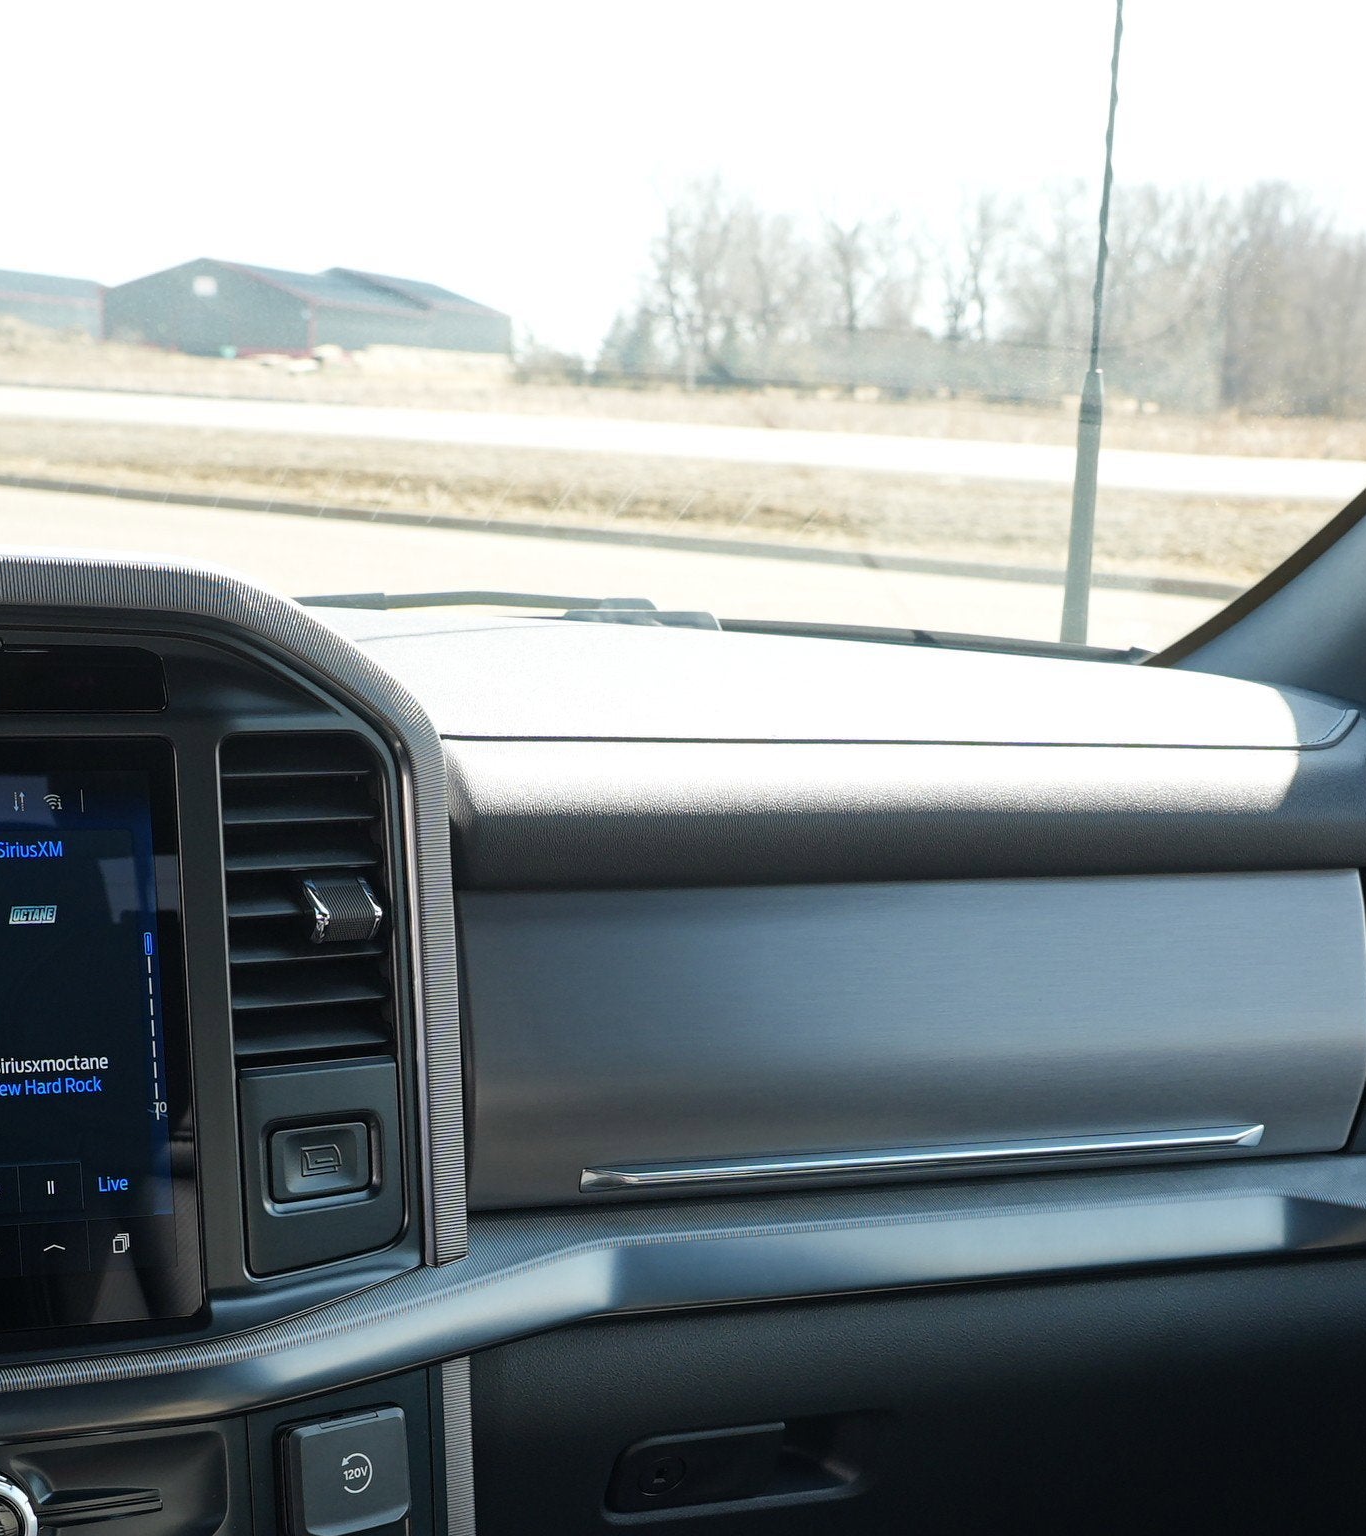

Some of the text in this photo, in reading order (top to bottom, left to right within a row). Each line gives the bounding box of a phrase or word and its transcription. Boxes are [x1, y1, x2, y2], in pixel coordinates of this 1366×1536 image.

[11, 907, 55, 922] OCTANE
[24, 1079, 62, 1096] Hard
[65, 1076, 102, 1094] Rock
[98, 1176, 129, 1193] Live
[343, 1465, 368, 1480] 120V
